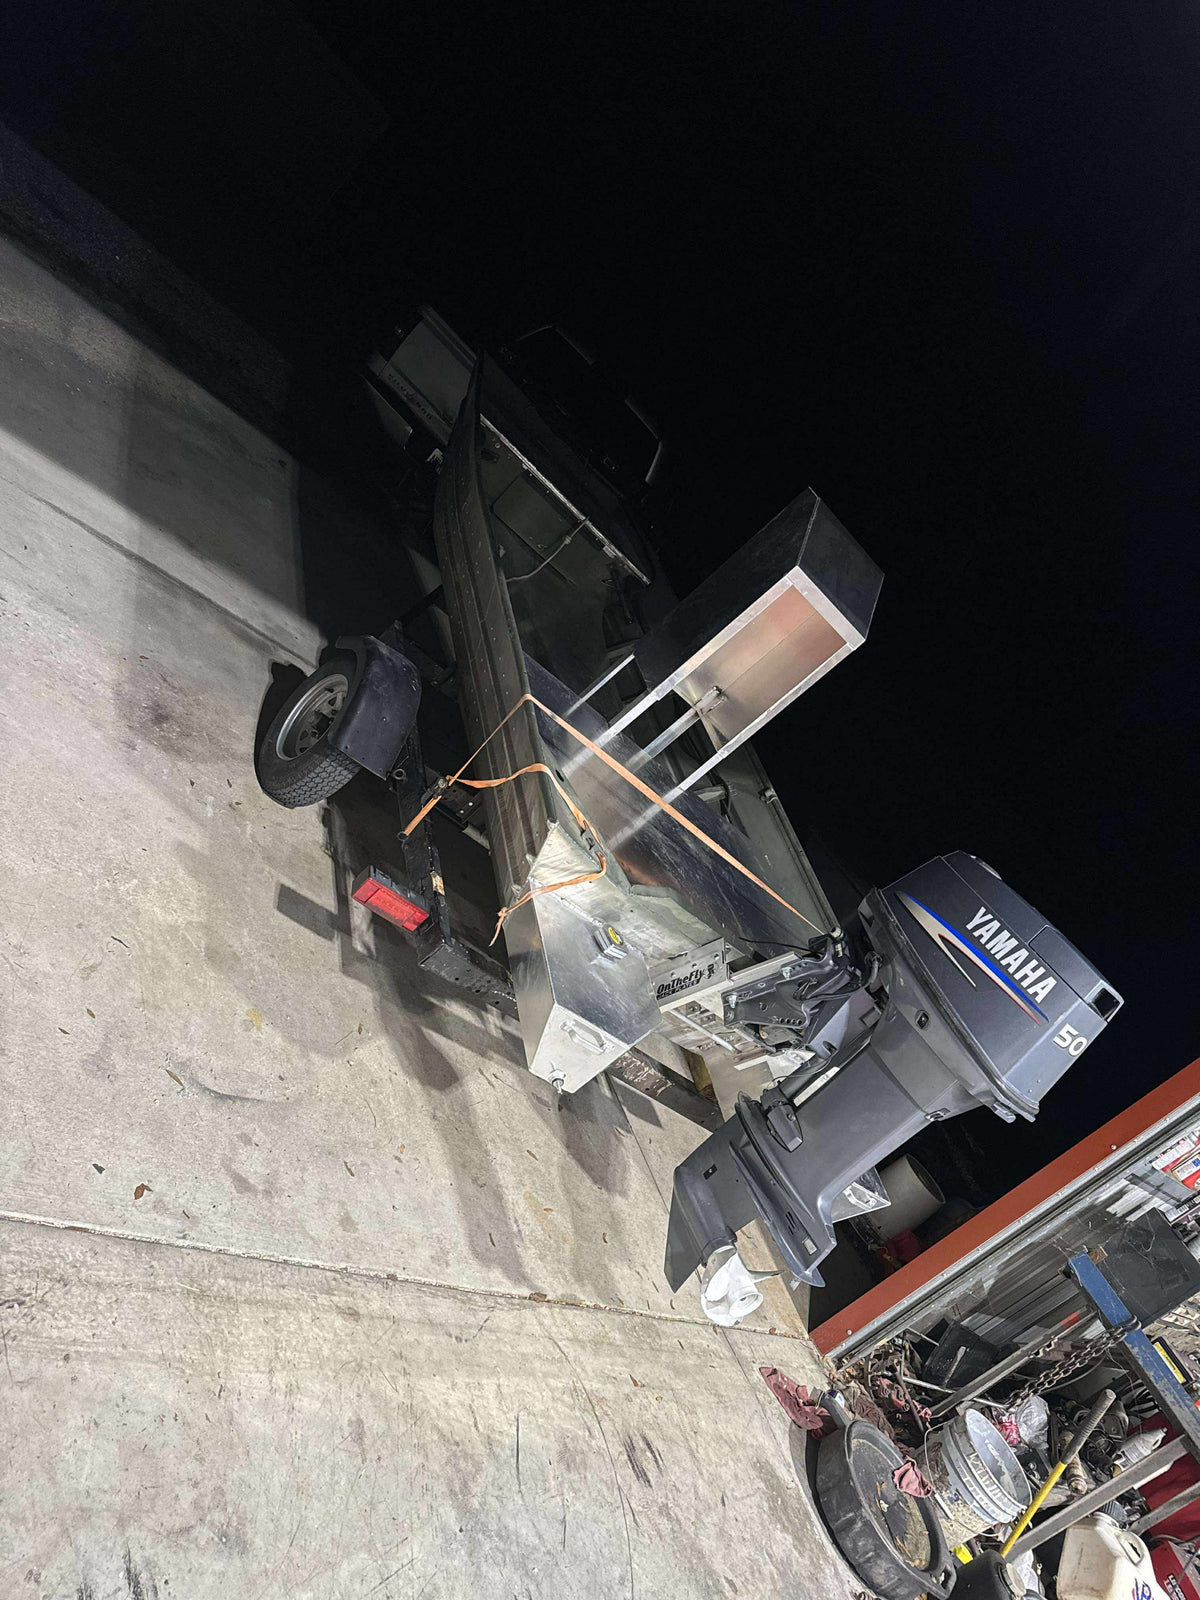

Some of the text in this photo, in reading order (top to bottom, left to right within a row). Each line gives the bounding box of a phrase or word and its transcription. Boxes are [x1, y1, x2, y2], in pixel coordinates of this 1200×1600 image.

[965, 906, 1058, 1004] YAMAHA
[656, 968, 704, 995] OnTheFly
[1052, 1023, 1088, 1057] 50
